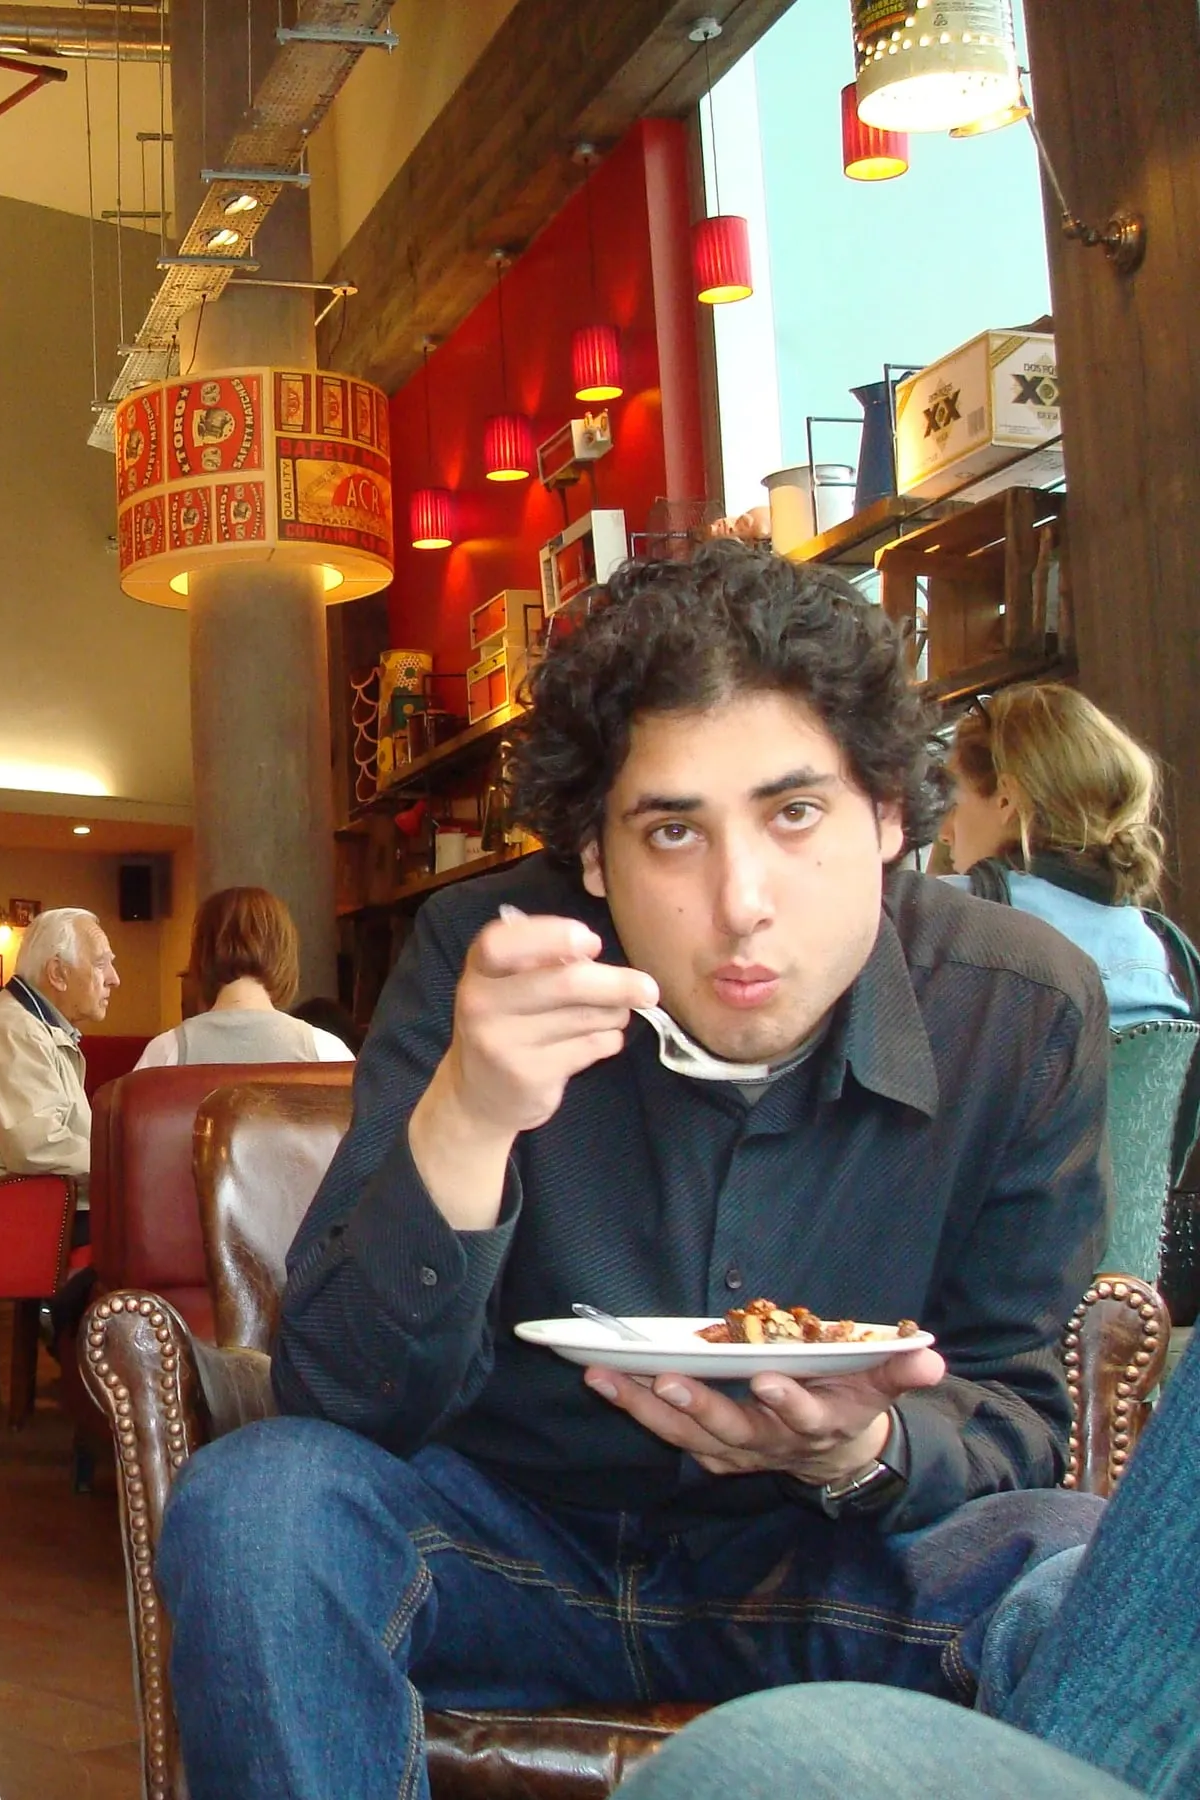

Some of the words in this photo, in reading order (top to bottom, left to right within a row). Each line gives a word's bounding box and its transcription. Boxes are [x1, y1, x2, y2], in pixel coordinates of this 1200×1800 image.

[231, 377, 255, 427] MATCHES
[173, 398, 187, 465] TORO
[232, 427, 255, 470] SAFETY
[280, 439, 357, 462] SAFETY
[142, 443, 157, 486] SAFETY
[282, 461, 293, 518] QUALITY
